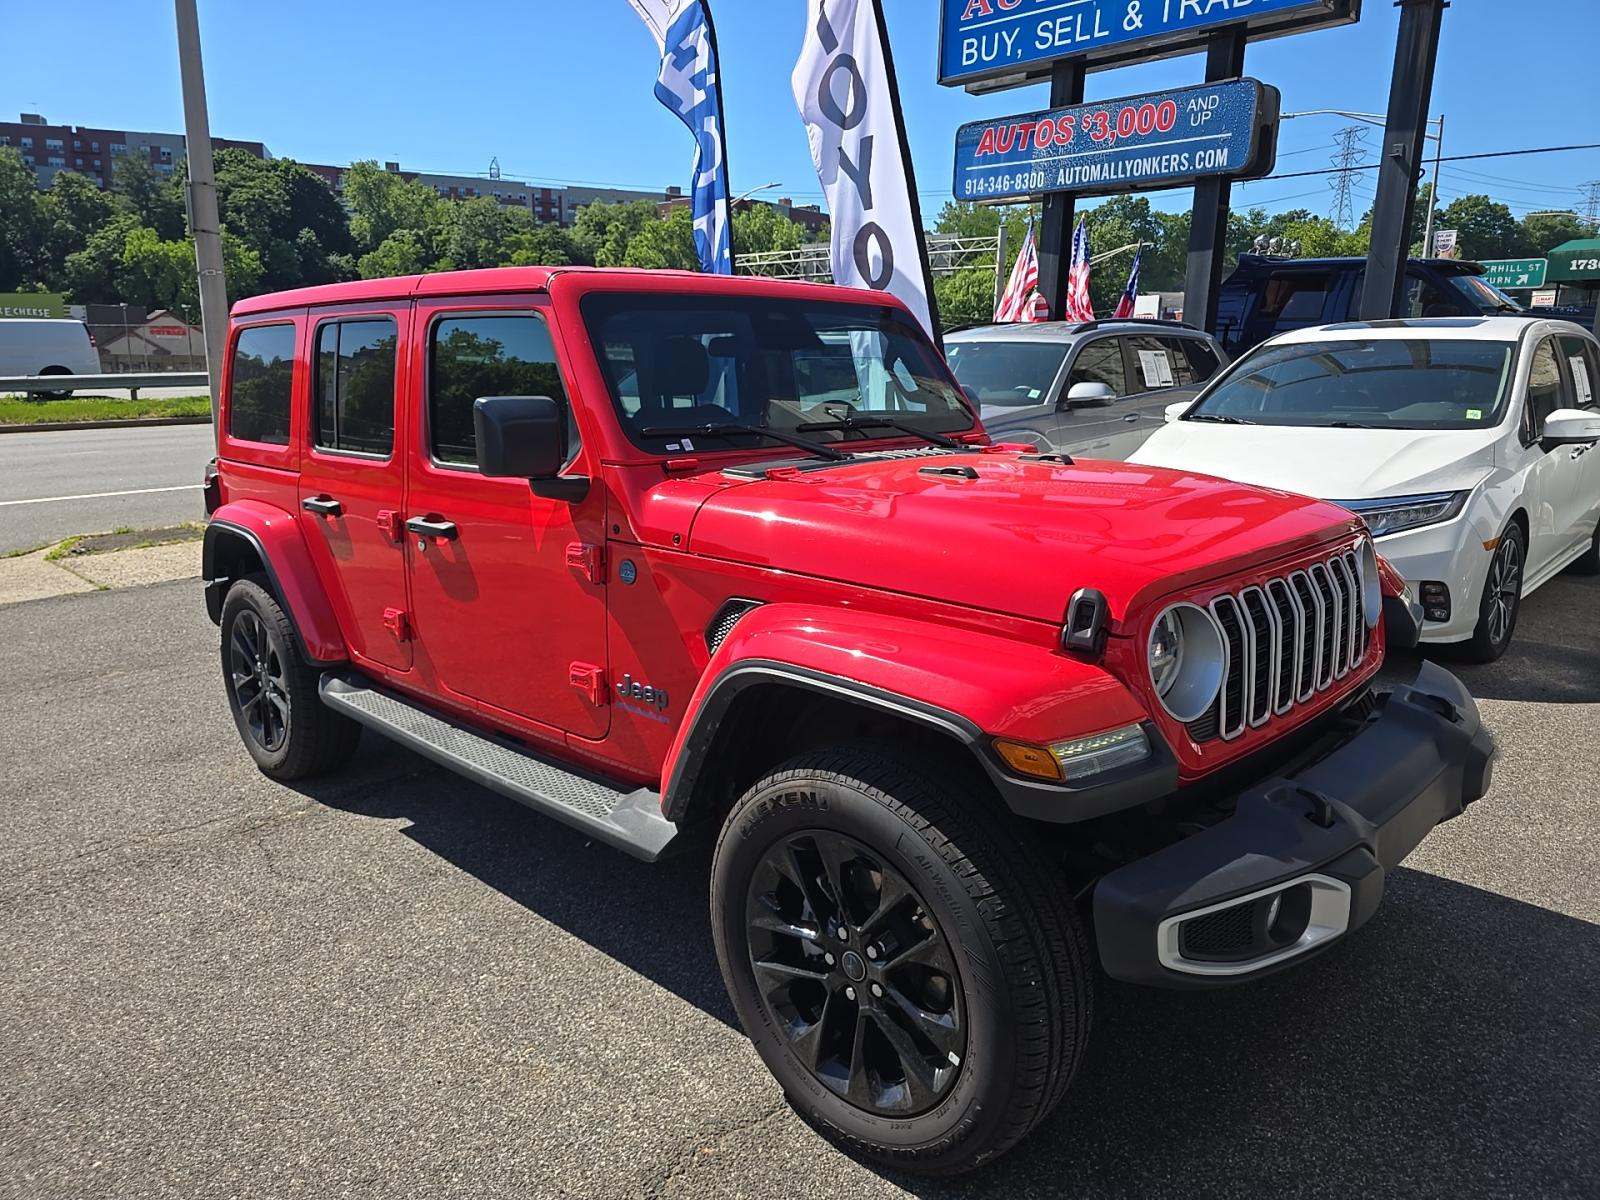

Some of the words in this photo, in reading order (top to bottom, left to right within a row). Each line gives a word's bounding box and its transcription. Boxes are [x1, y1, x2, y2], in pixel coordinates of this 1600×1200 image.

[961, 27, 1022, 66] BUY,
[1035, 8, 1110, 50] SELL
[1122, 0, 1143, 31] &
[1186, 95, 1219, 112] AND
[1190, 112, 1212, 127] UP
[975, 115, 1075, 157] AUTOS
[1081, 100, 1177, 145] $3,000
[965, 171, 1045, 195] 914-346-8300
[1056, 148, 1229, 186] AUTOMALLYONKERS.COM
[1528, 263, 1541, 272] ST
[1569, 258, 1600, 271] 173
[13, 307, 51, 318] CHEESE
[616, 673, 669, 712] Jeep
